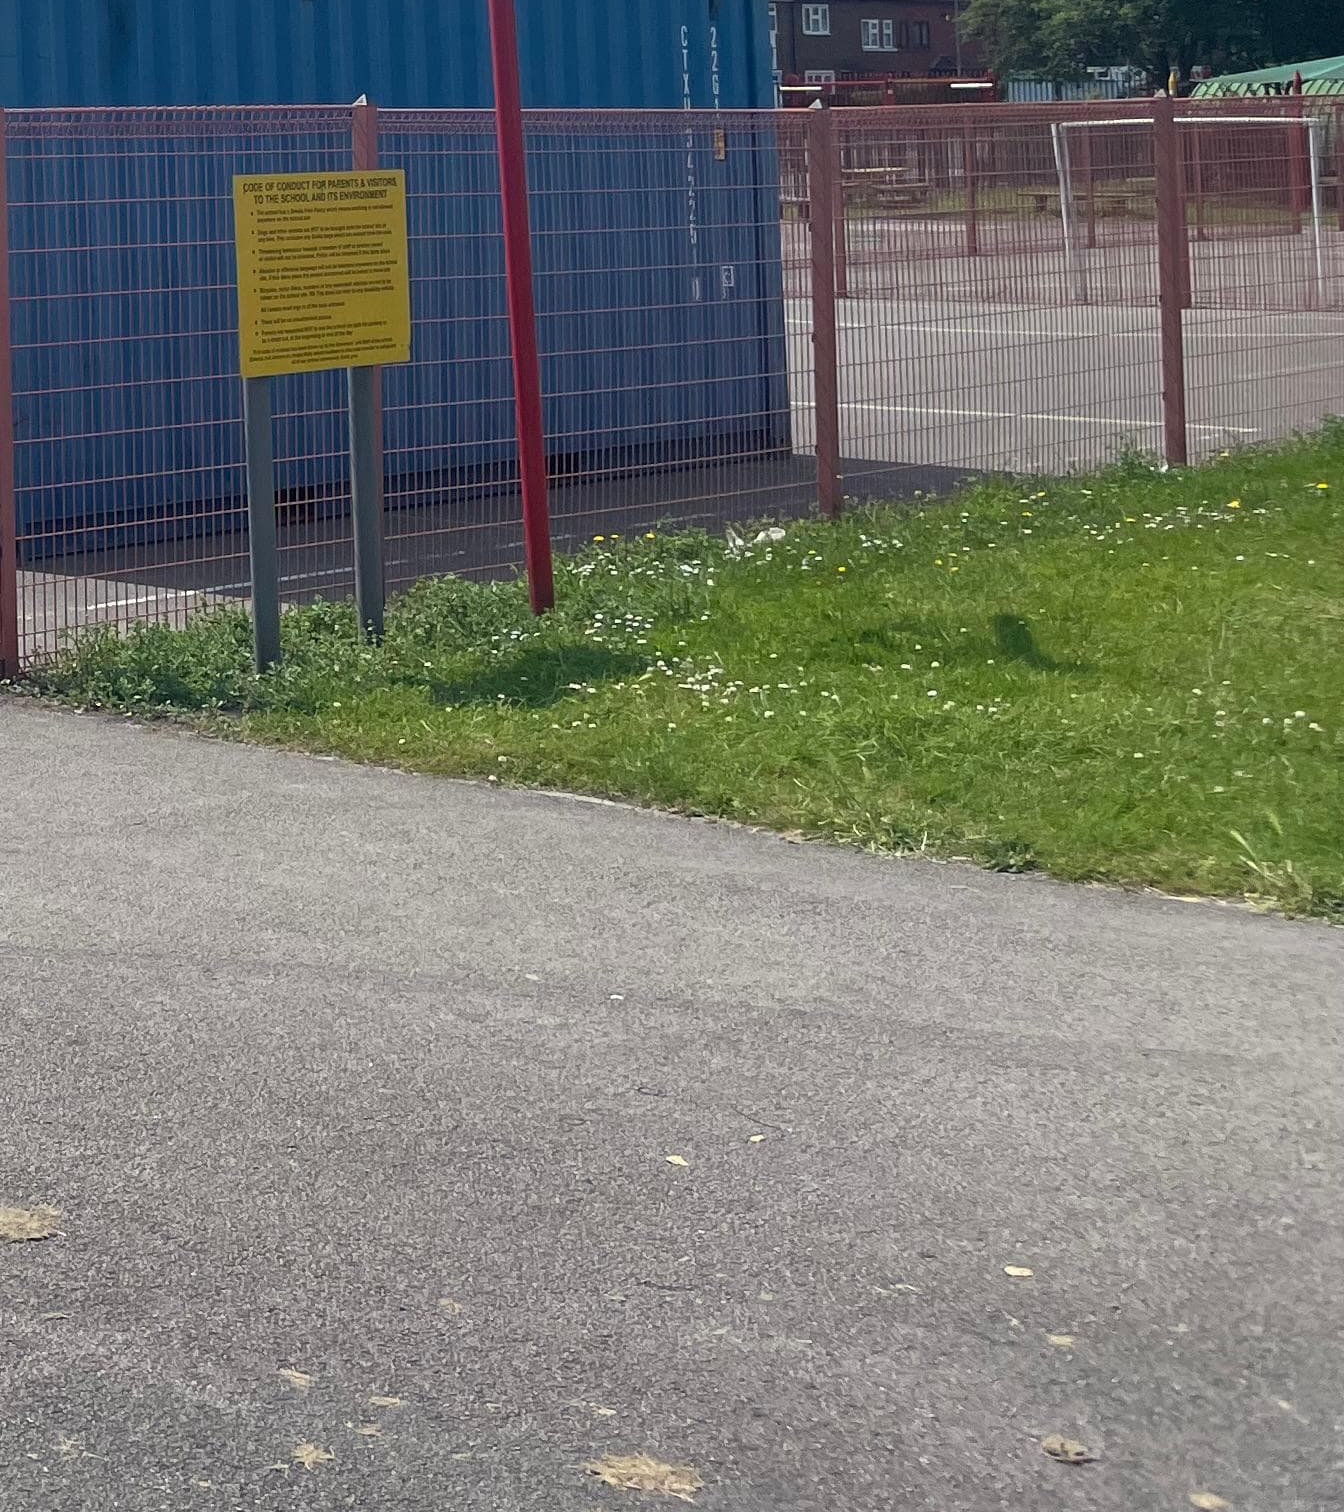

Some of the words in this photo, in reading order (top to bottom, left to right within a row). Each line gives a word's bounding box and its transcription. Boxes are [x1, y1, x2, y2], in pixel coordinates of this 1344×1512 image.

[243, 182, 263, 193] CODE
[265, 182, 275, 191] OF
[276, 180, 310, 191] CONDUCT
[312, 179, 327, 189] FOR
[327, 178, 358, 188] PARENTS
[367, 177, 397, 187] VISITORS
[254, 194, 264, 204] TO
[266, 194, 279, 203] THE
[281, 192, 310, 203] SCHOOL
[311, 191, 326, 201] AND
[327, 190, 338, 200] ITS
[339, 189, 387, 200] ENVIRONMENT
